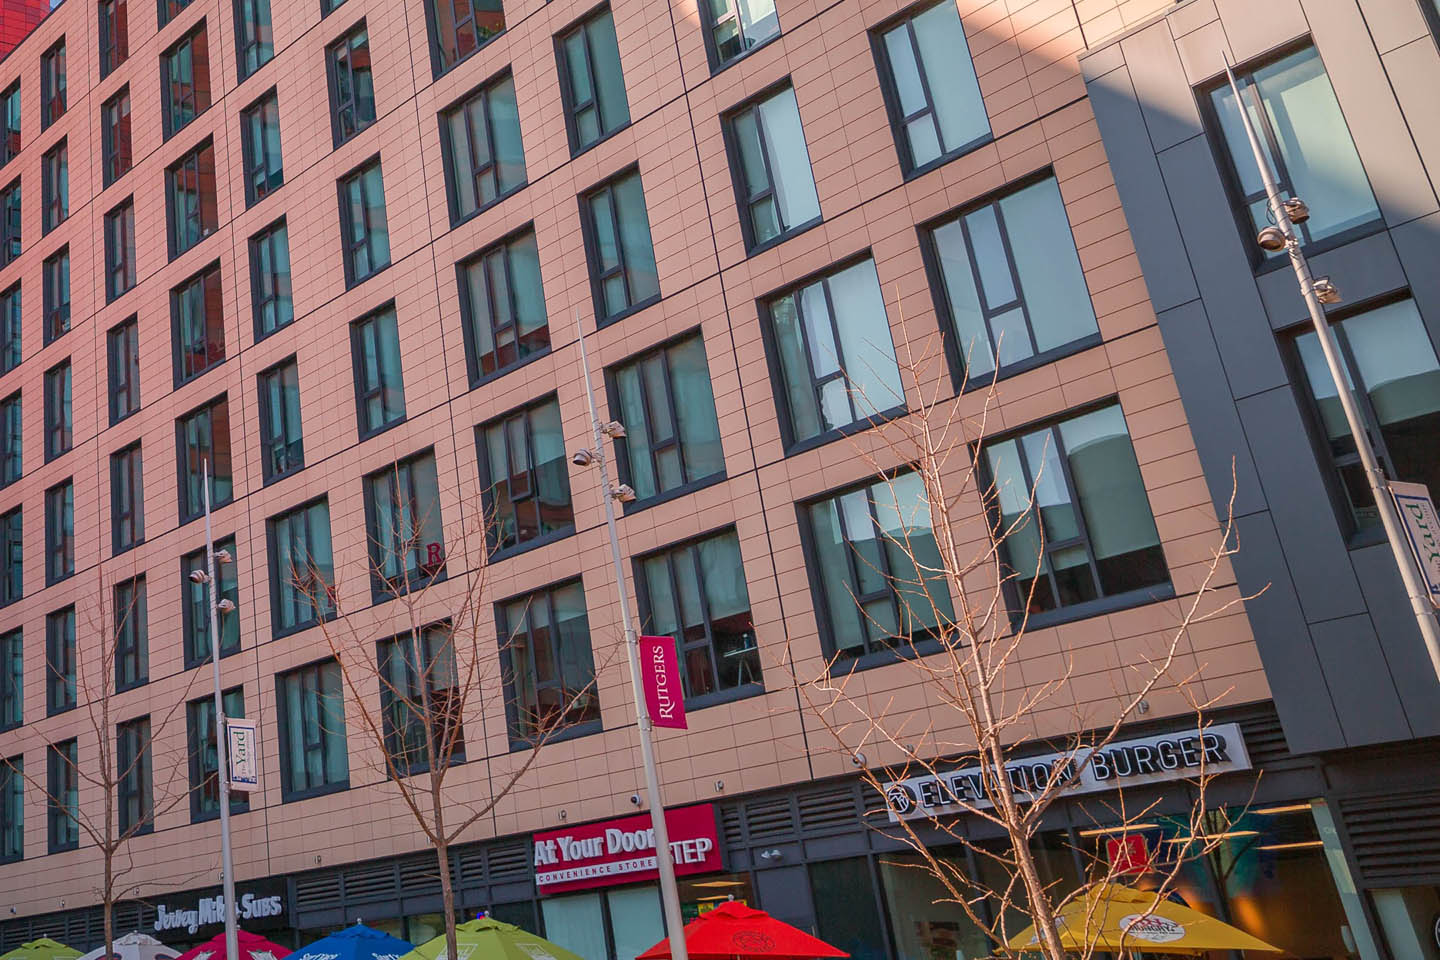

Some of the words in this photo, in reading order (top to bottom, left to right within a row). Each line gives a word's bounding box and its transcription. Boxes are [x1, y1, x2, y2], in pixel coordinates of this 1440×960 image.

[426, 542, 442, 566] R
[652, 645, 676, 720] RUTGERS
[232, 730, 246, 765] Yard
[1090, 733, 1227, 782] BURGER
[534, 840, 559, 867] At
[556, 835, 604, 862] Your
[667, 837, 713, 865] TEP
[538, 866, 611, 883] CONVENIENCE
[618, 859, 653, 871] STORE
[154, 904, 199, 935] Jersey
